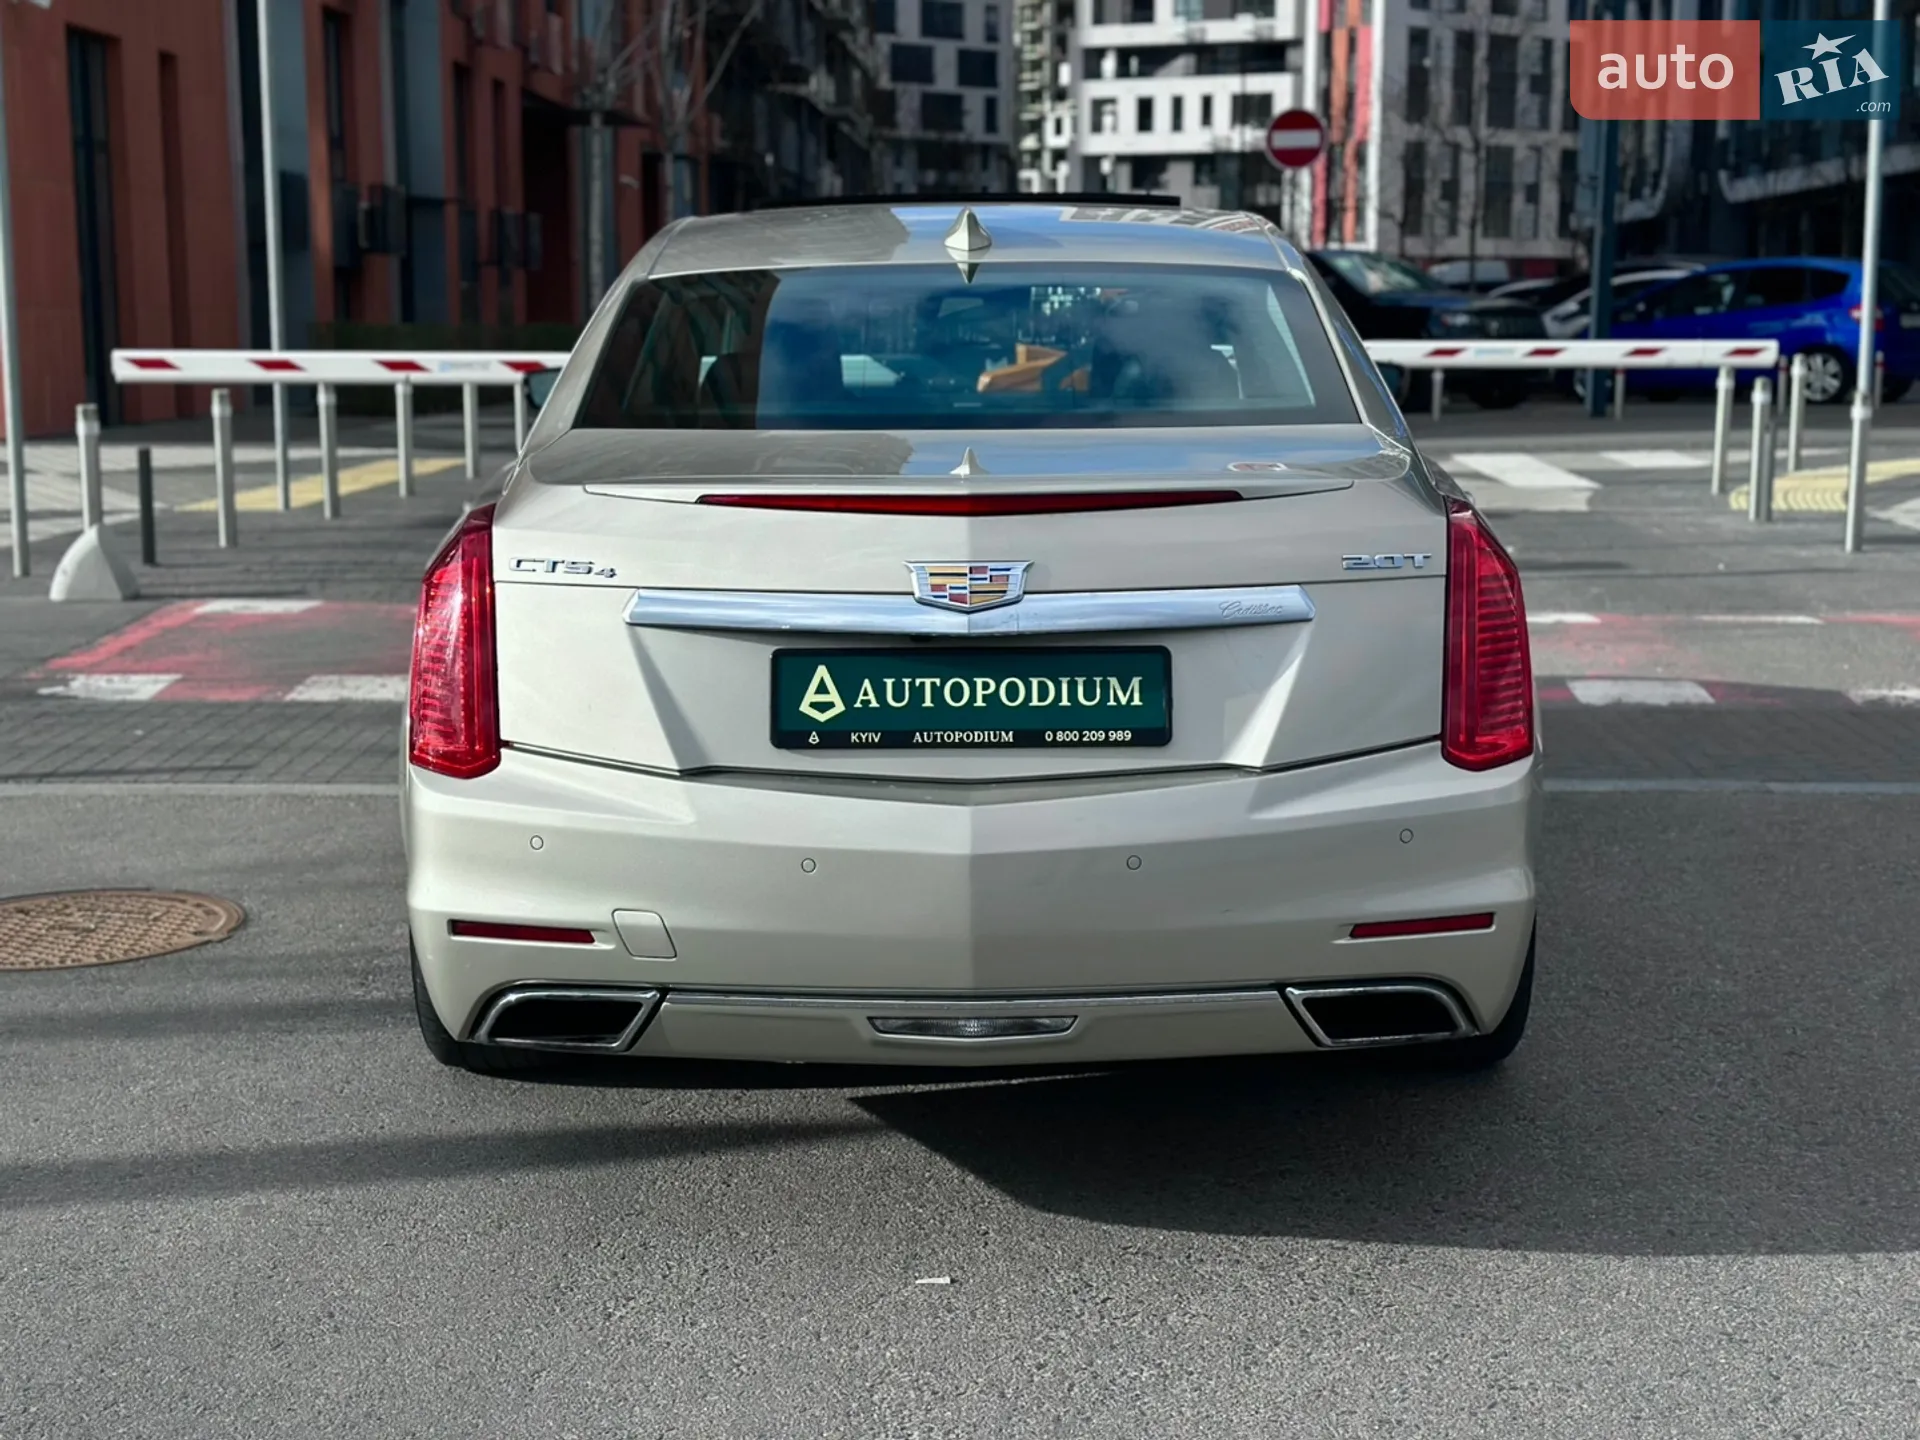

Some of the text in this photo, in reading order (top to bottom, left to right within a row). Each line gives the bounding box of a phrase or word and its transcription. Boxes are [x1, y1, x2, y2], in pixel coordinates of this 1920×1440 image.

[1219, 600, 1283, 619] Cadillac
[853, 676, 1143, 708] AUTOPODIUM
[850, 730, 1132, 743] KYIV AUTOPODIUM 0 800 209 989
